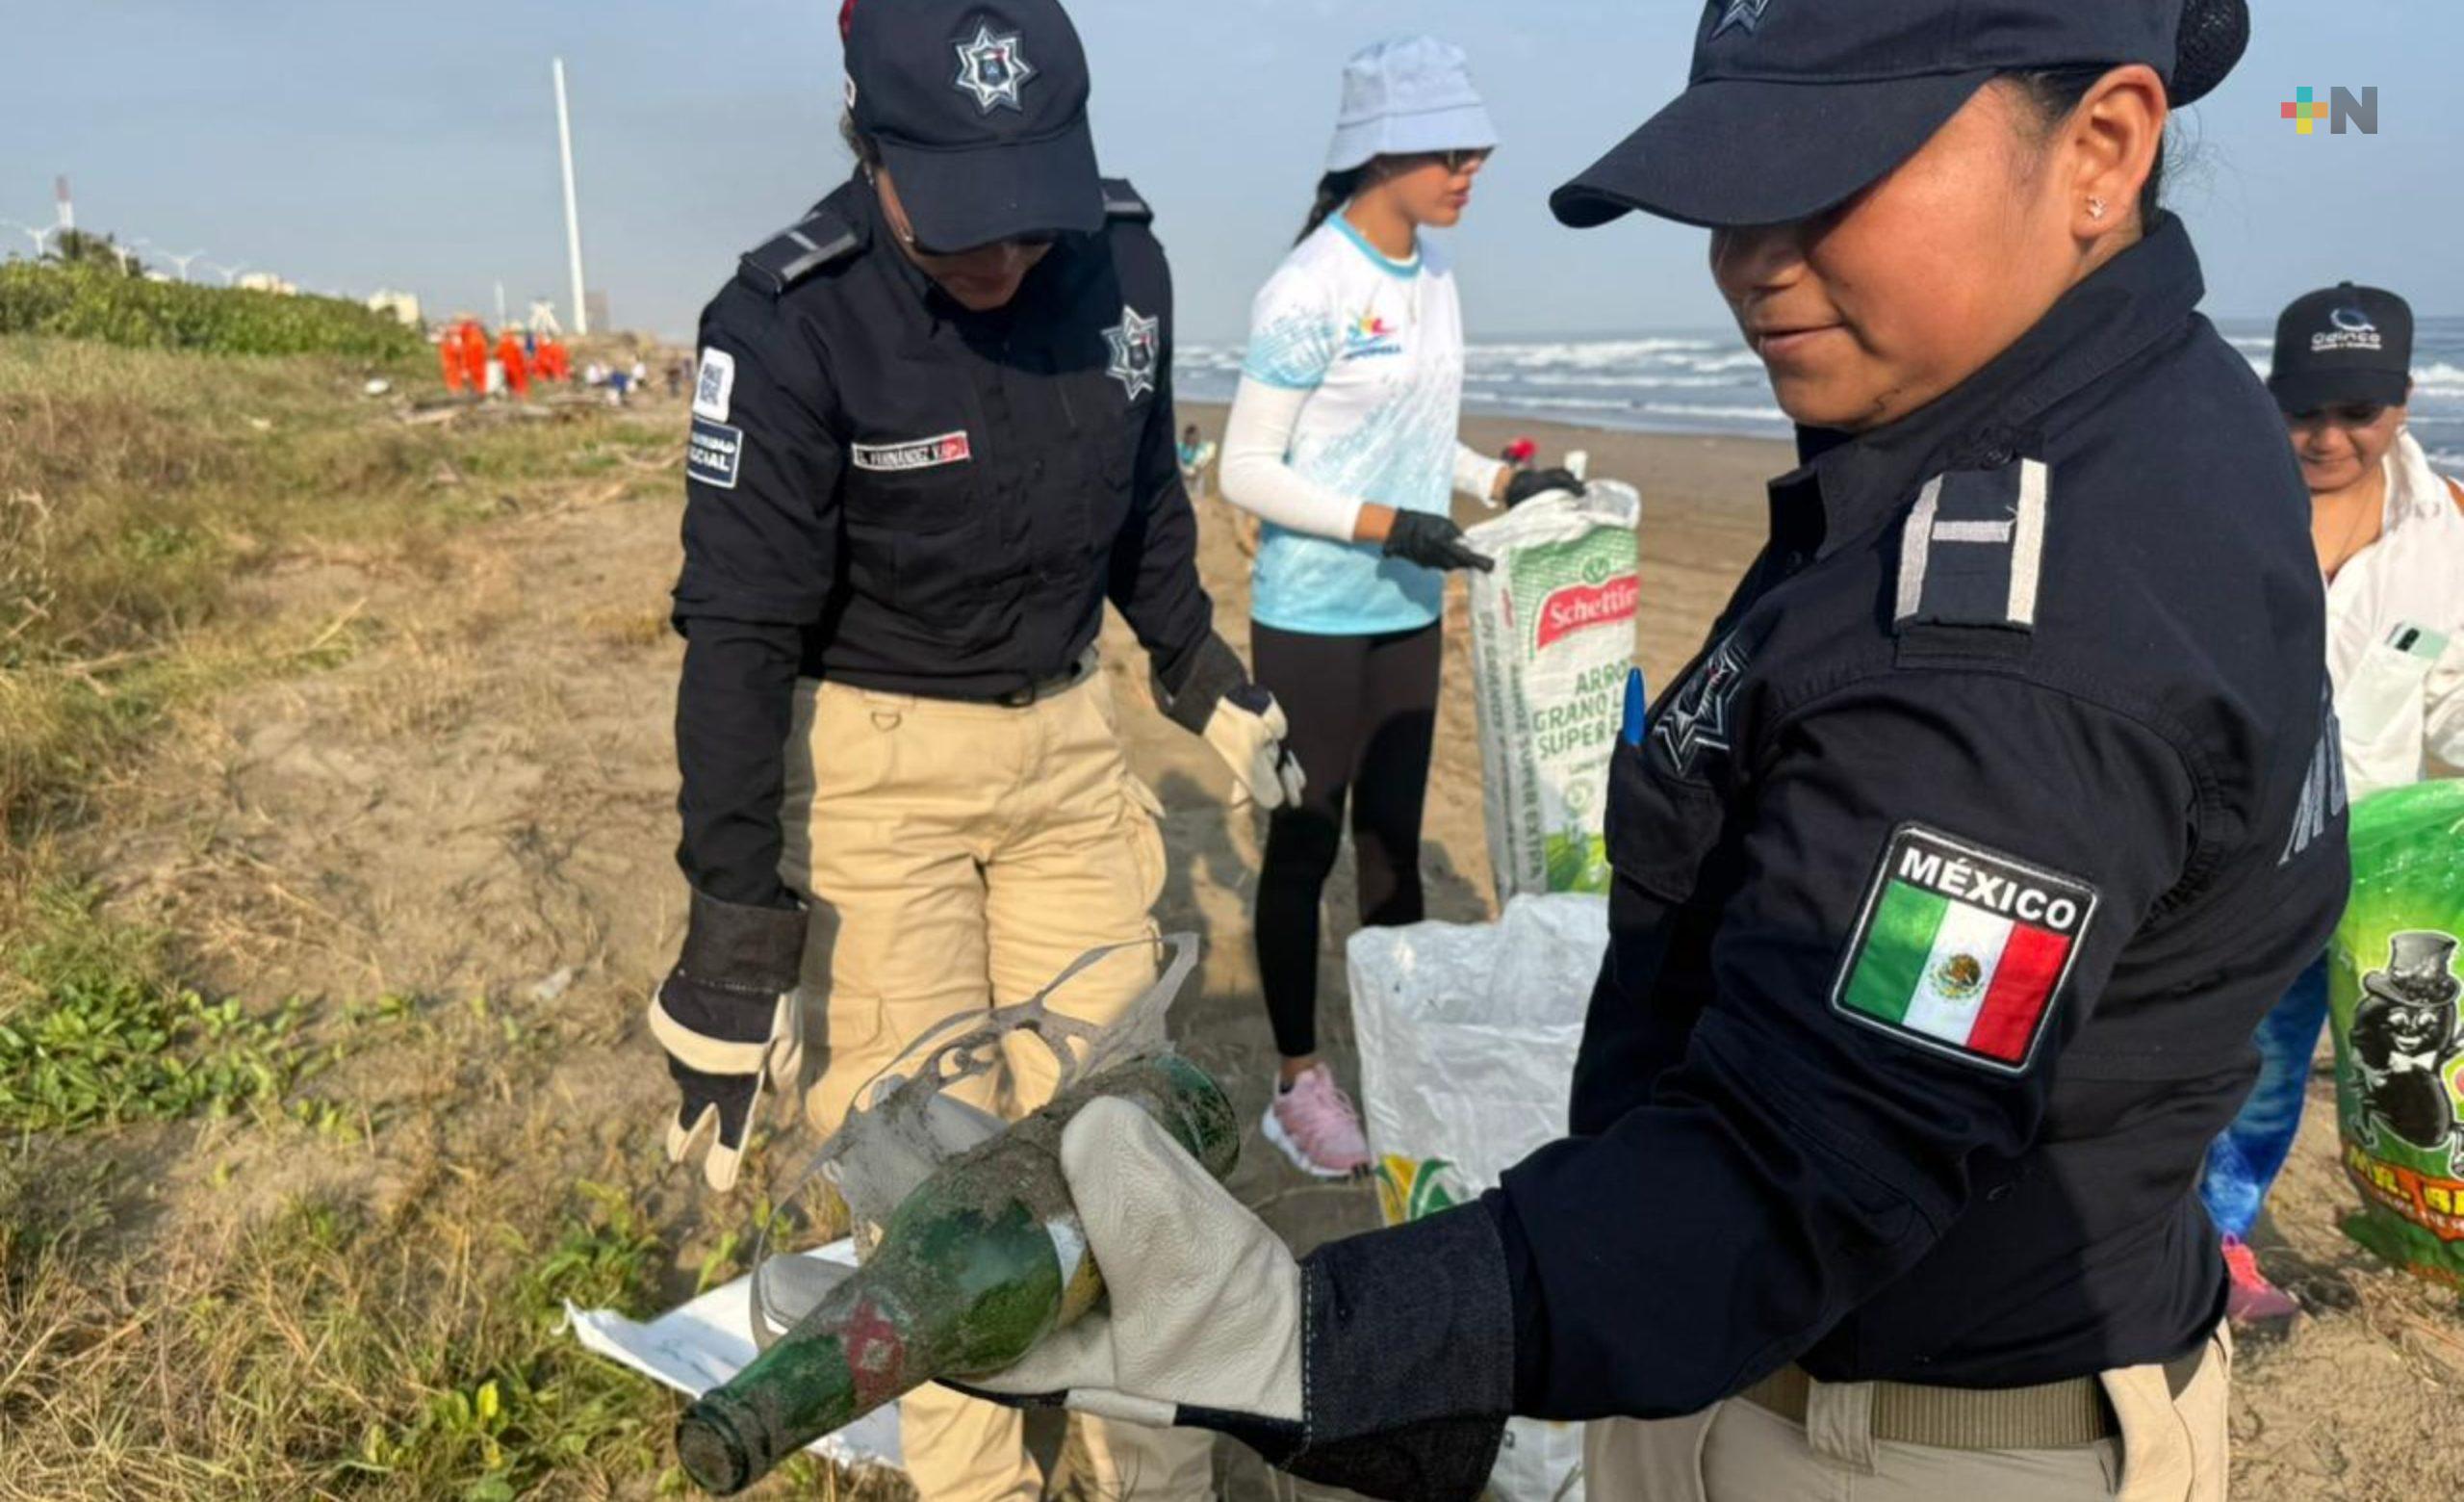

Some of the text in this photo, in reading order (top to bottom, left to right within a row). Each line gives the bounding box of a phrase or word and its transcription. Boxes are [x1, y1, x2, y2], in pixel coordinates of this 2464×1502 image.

[1576, 658, 1630, 696] ARRO
[1532, 691, 1608, 733] GRANO
[1898, 846, 2077, 930] MÉXICO
